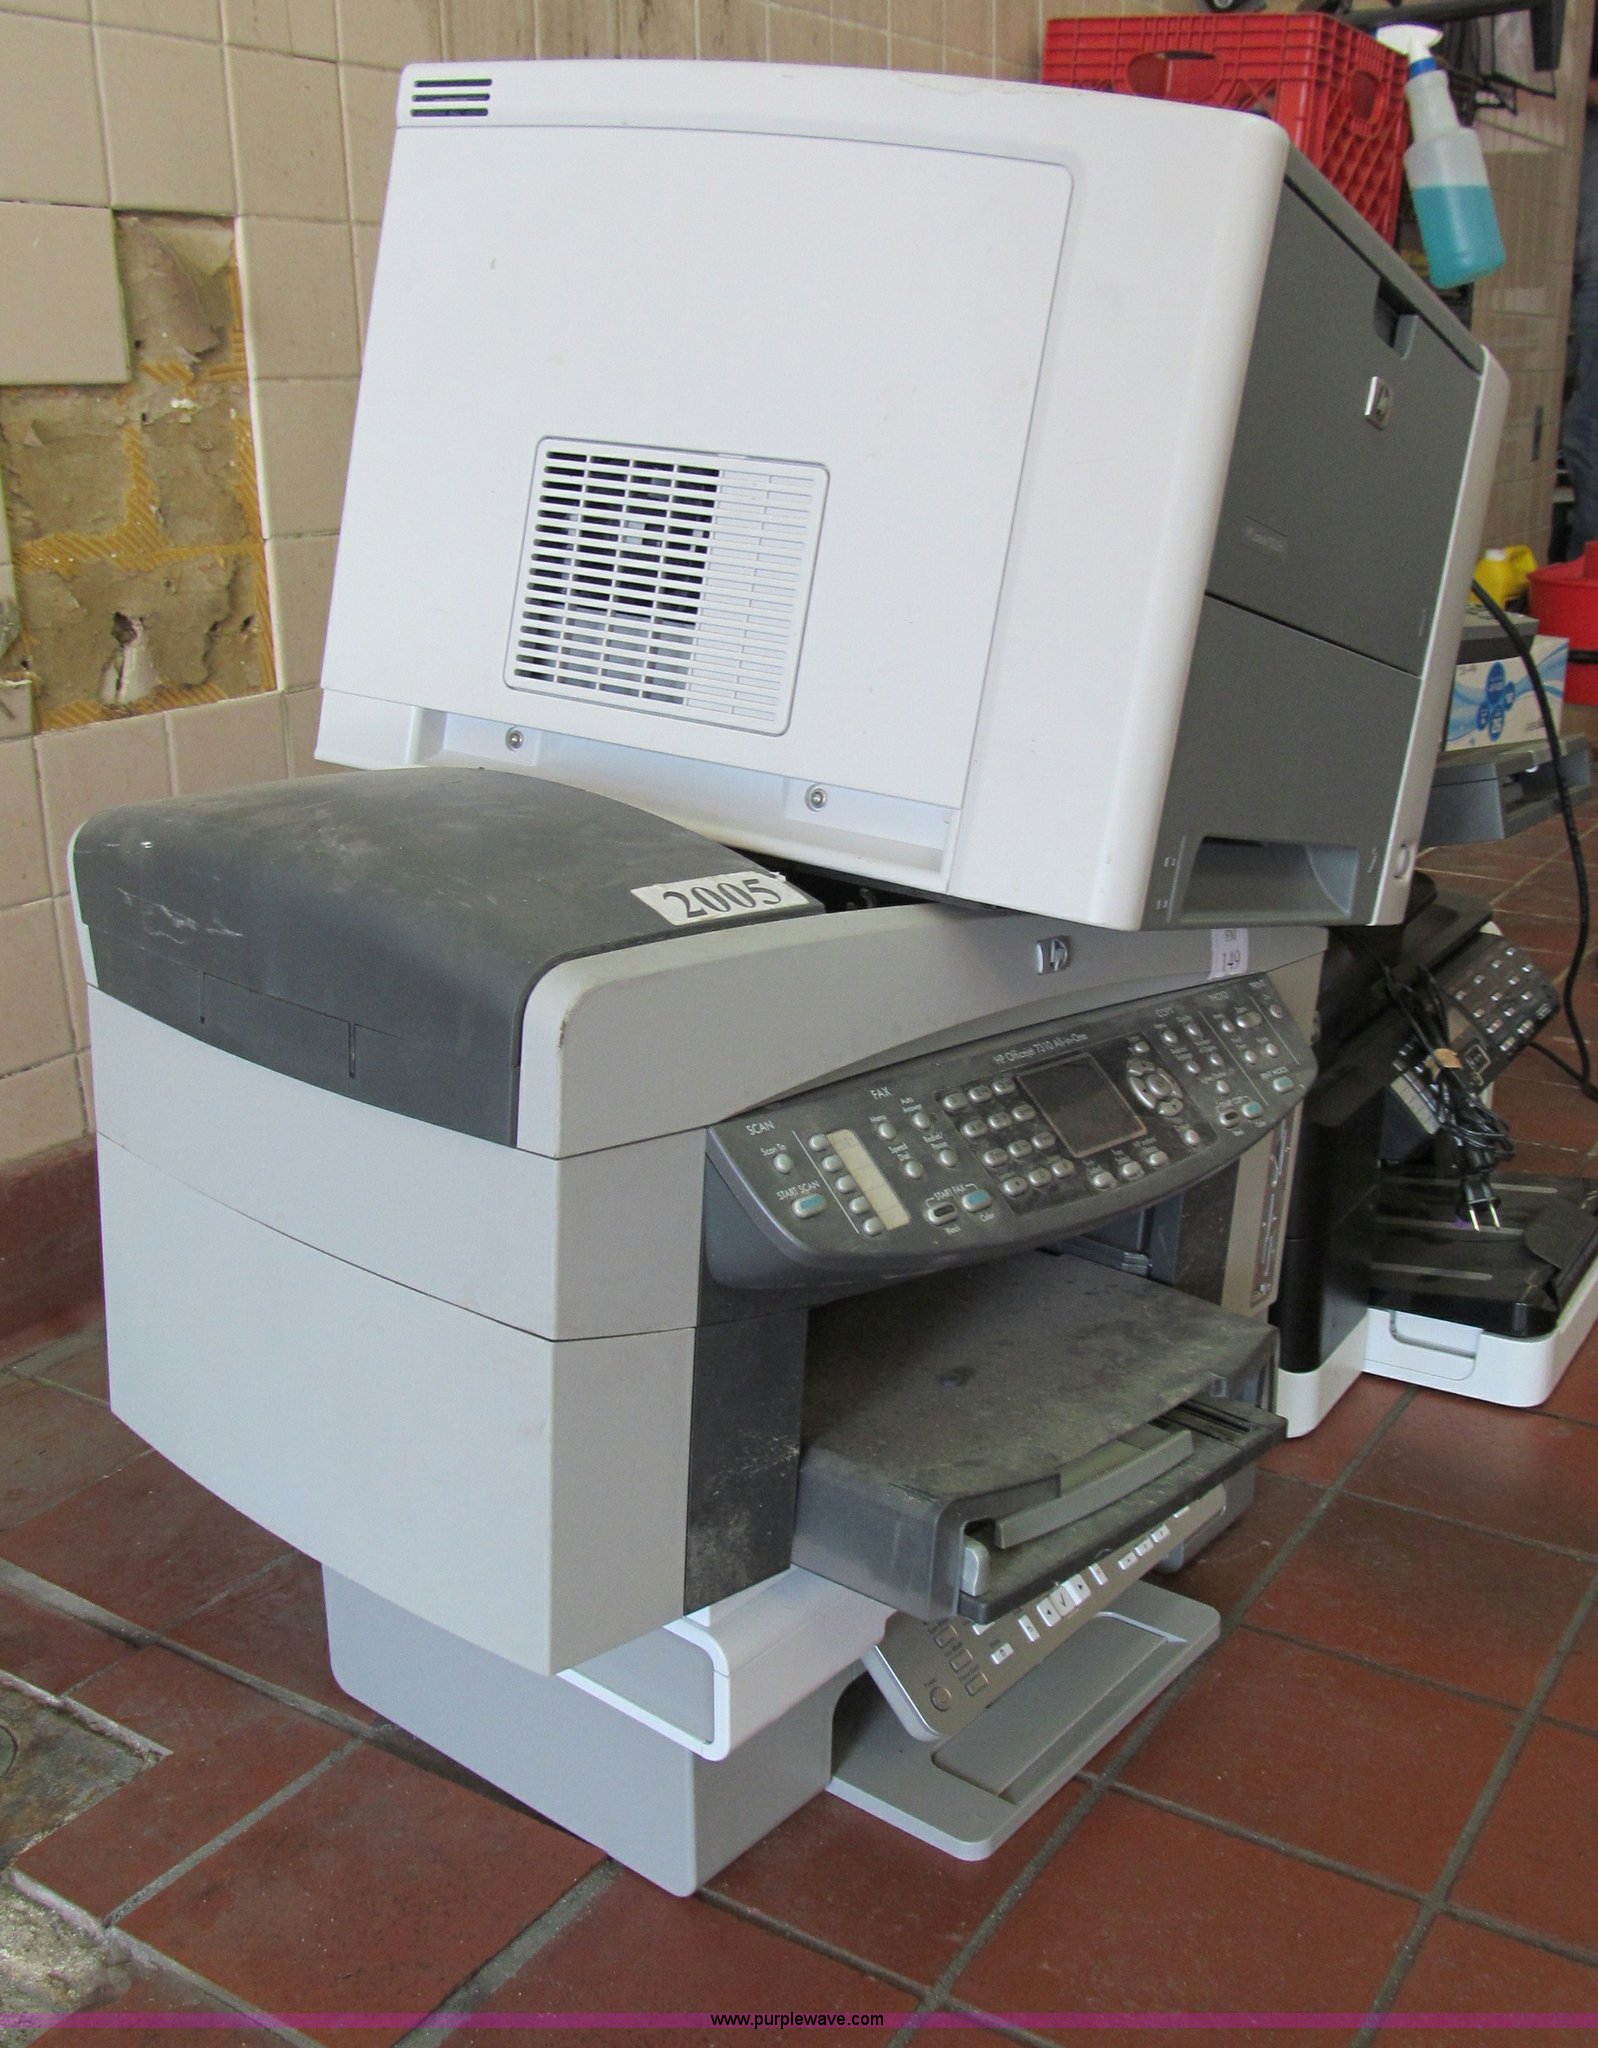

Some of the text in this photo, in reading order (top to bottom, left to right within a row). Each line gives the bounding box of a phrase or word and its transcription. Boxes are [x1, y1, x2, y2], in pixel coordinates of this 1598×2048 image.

[662, 878, 782, 918] 2005
[870, 1086, 892, 1100] FAX
[746, 1120, 776, 1136] SCAN
[760, 1143, 787, 1157] Scan To
[776, 1180, 821, 1201] START SCAN
